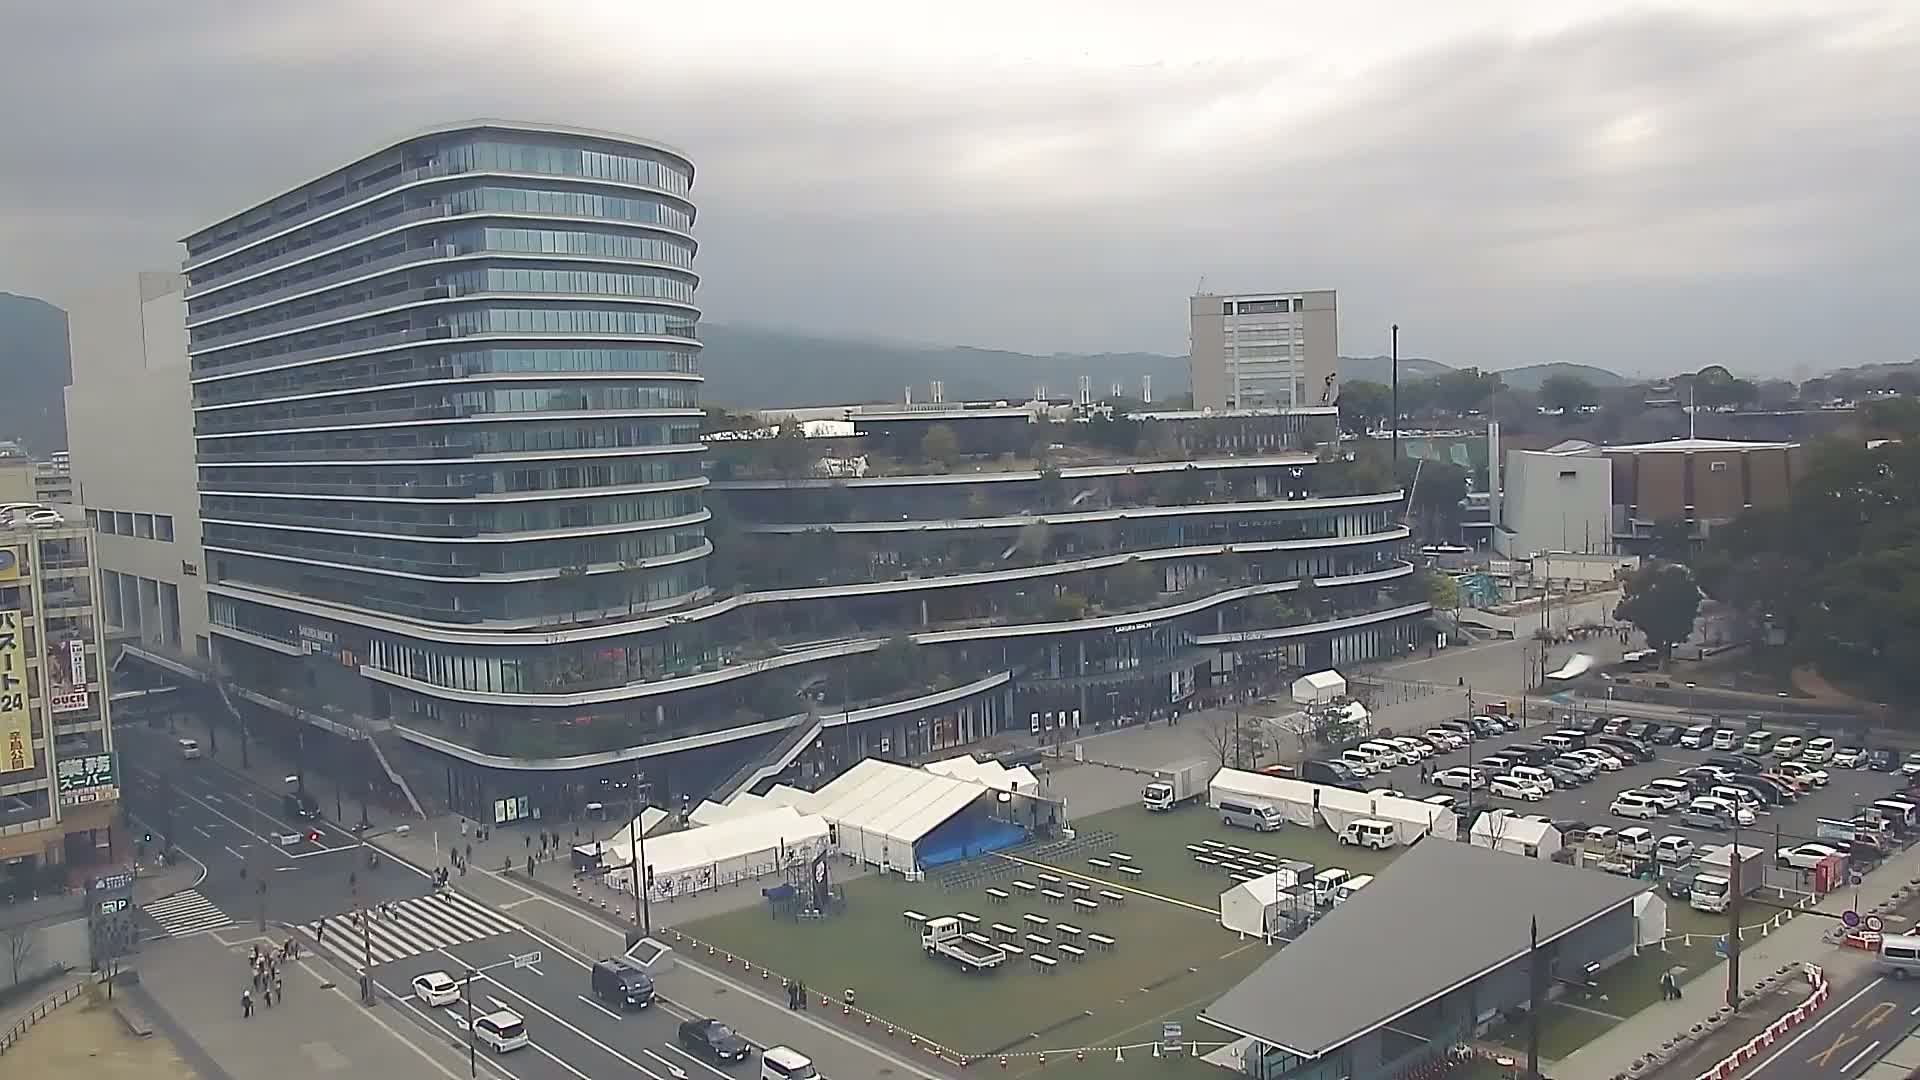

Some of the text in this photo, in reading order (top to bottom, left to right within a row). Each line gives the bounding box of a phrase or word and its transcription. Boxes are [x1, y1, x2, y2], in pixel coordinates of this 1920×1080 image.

[60, 773, 112, 790] スーパー
[118, 900, 127, 910] P
